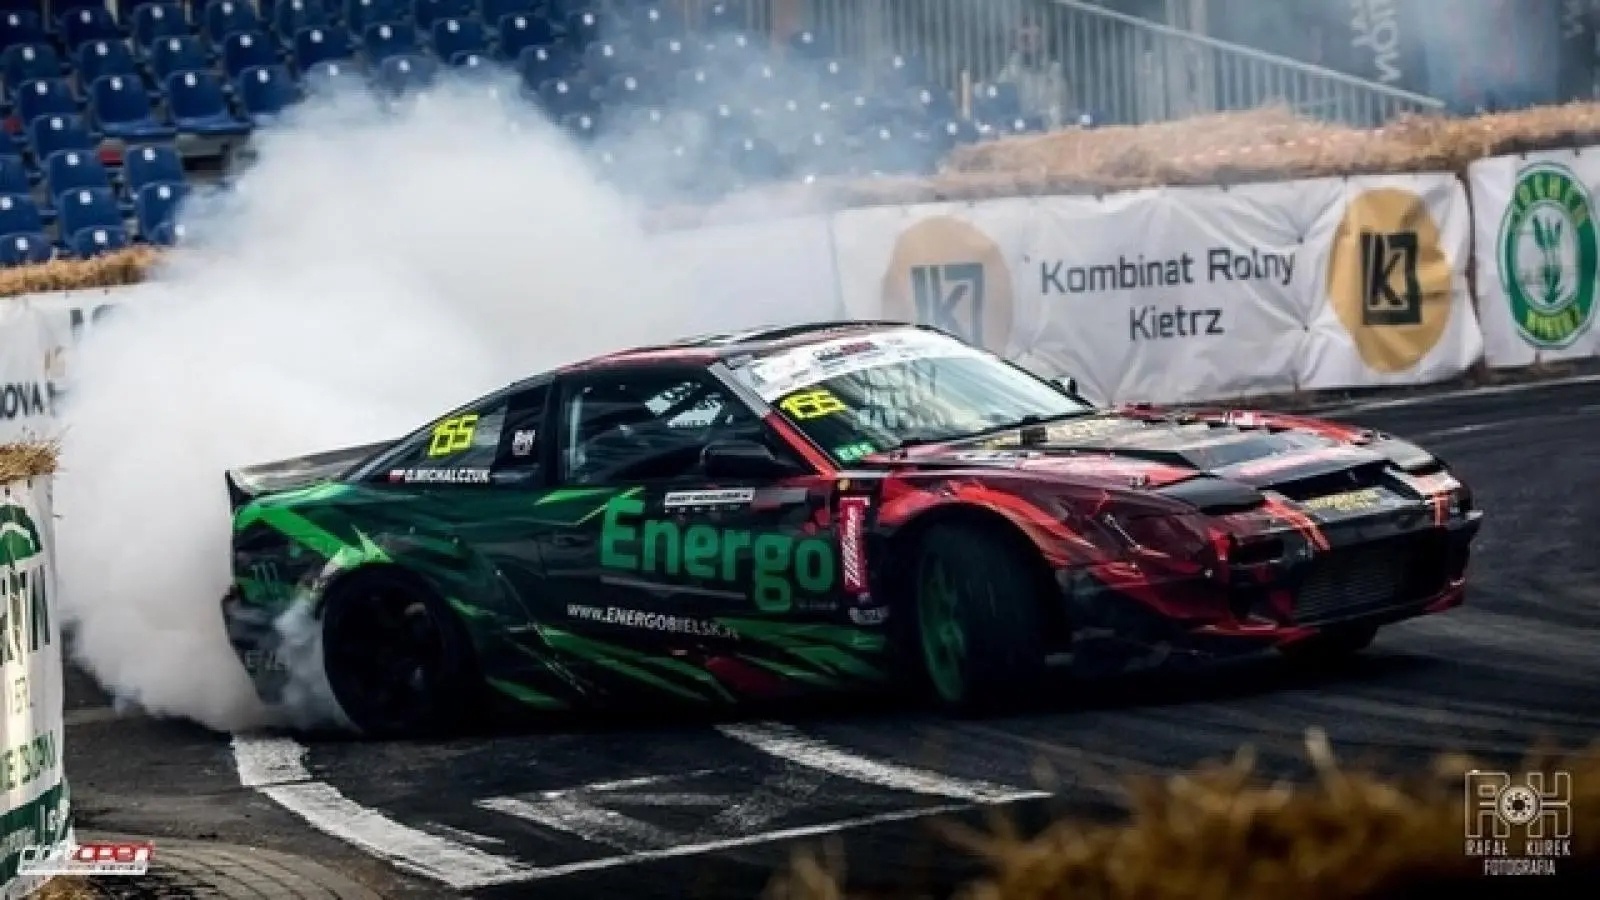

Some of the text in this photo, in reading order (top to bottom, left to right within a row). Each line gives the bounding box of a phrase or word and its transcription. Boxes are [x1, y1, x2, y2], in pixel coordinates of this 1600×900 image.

[1040, 246, 1296, 294] Kombinat Rolny
[1129, 307, 1224, 342] Kietrz
[779, 389, 848, 420] 155
[428, 413, 479, 457] 155
[600, 498, 835, 612] Energo
